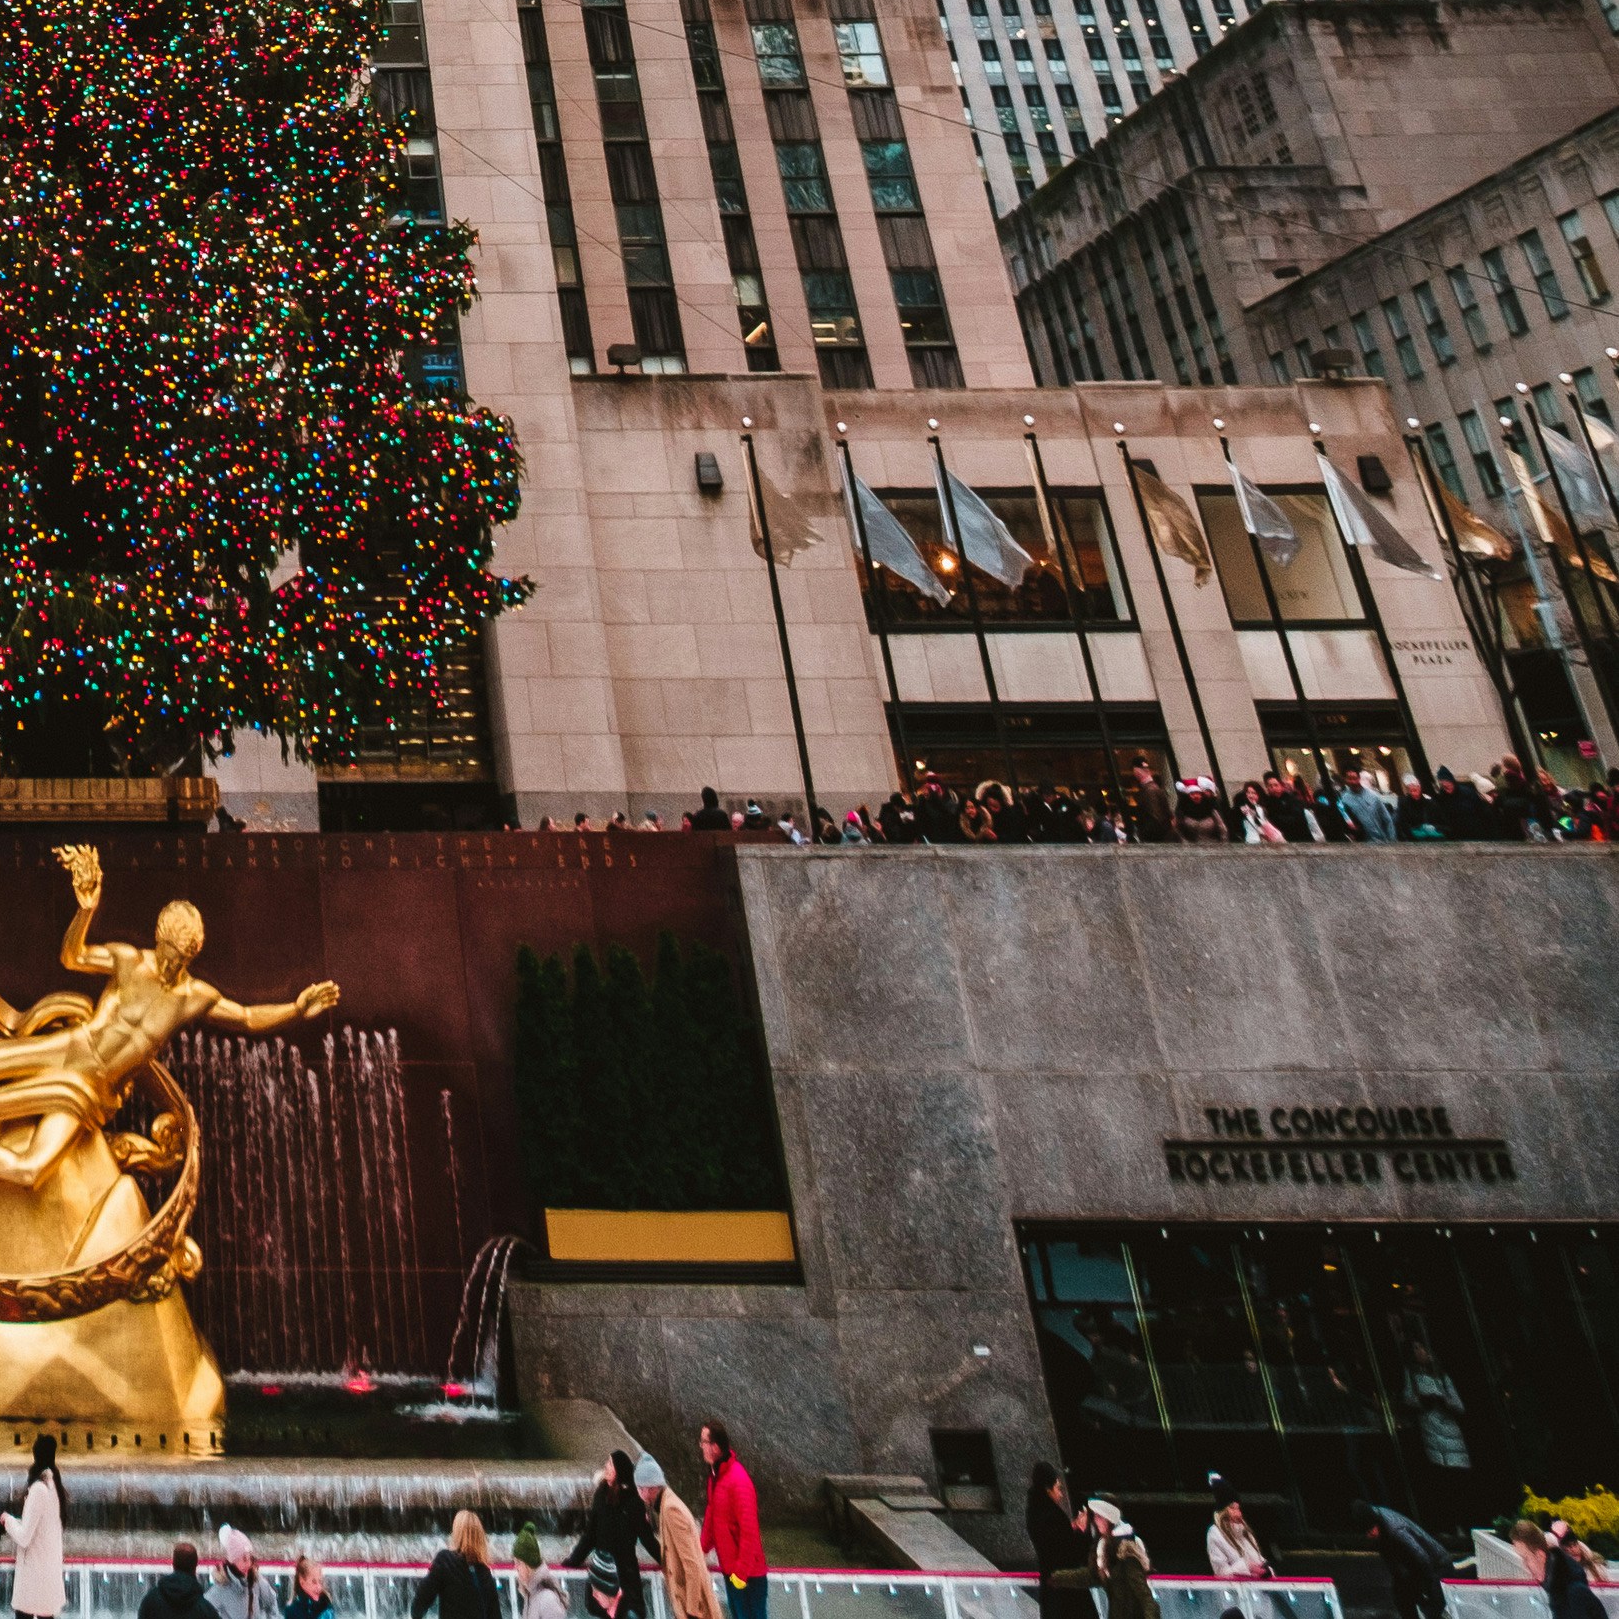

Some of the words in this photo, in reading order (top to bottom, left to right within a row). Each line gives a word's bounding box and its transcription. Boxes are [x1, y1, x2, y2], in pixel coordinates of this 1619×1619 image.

[1390, 640, 1470, 651] OCKEFELLER
[1205, 1106, 1263, 1137] THE
[1270, 1104, 1454, 1137] CONCOURSE
[1165, 1150, 1383, 1185] ROCKEFELLER
[1391, 1149, 1517, 1184] CENTER
